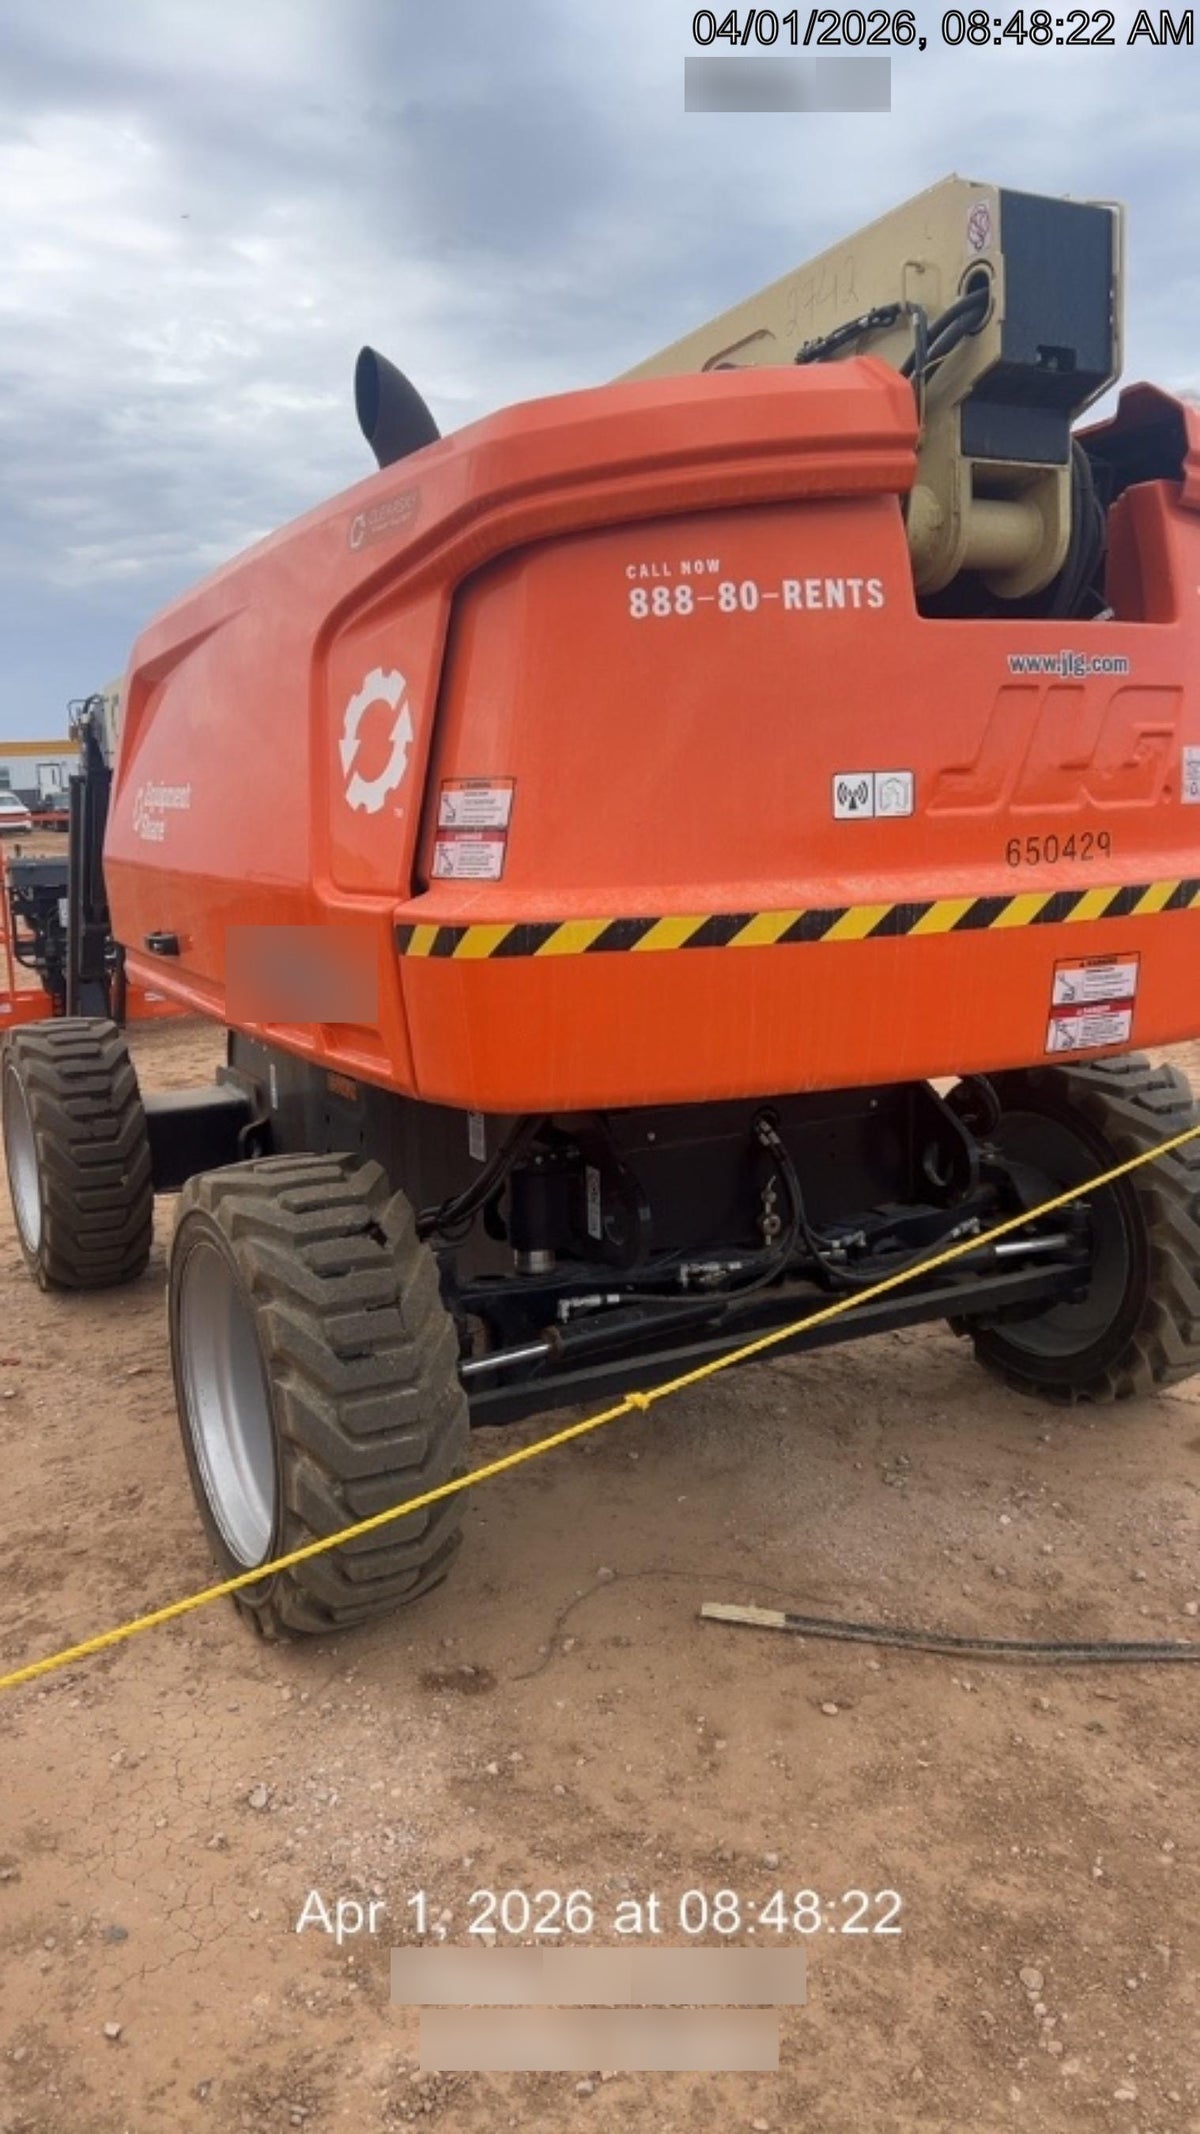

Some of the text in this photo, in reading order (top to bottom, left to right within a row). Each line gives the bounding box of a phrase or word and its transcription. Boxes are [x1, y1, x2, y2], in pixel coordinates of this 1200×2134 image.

[625, 558, 721, 579] CALL NOW
[628, 578, 885, 619] 888-80-RENTS
[1007, 649, 1129, 678] www.jlg.com
[925, 684, 1184, 816] JLG
[1005, 831, 1111, 868] 650429
